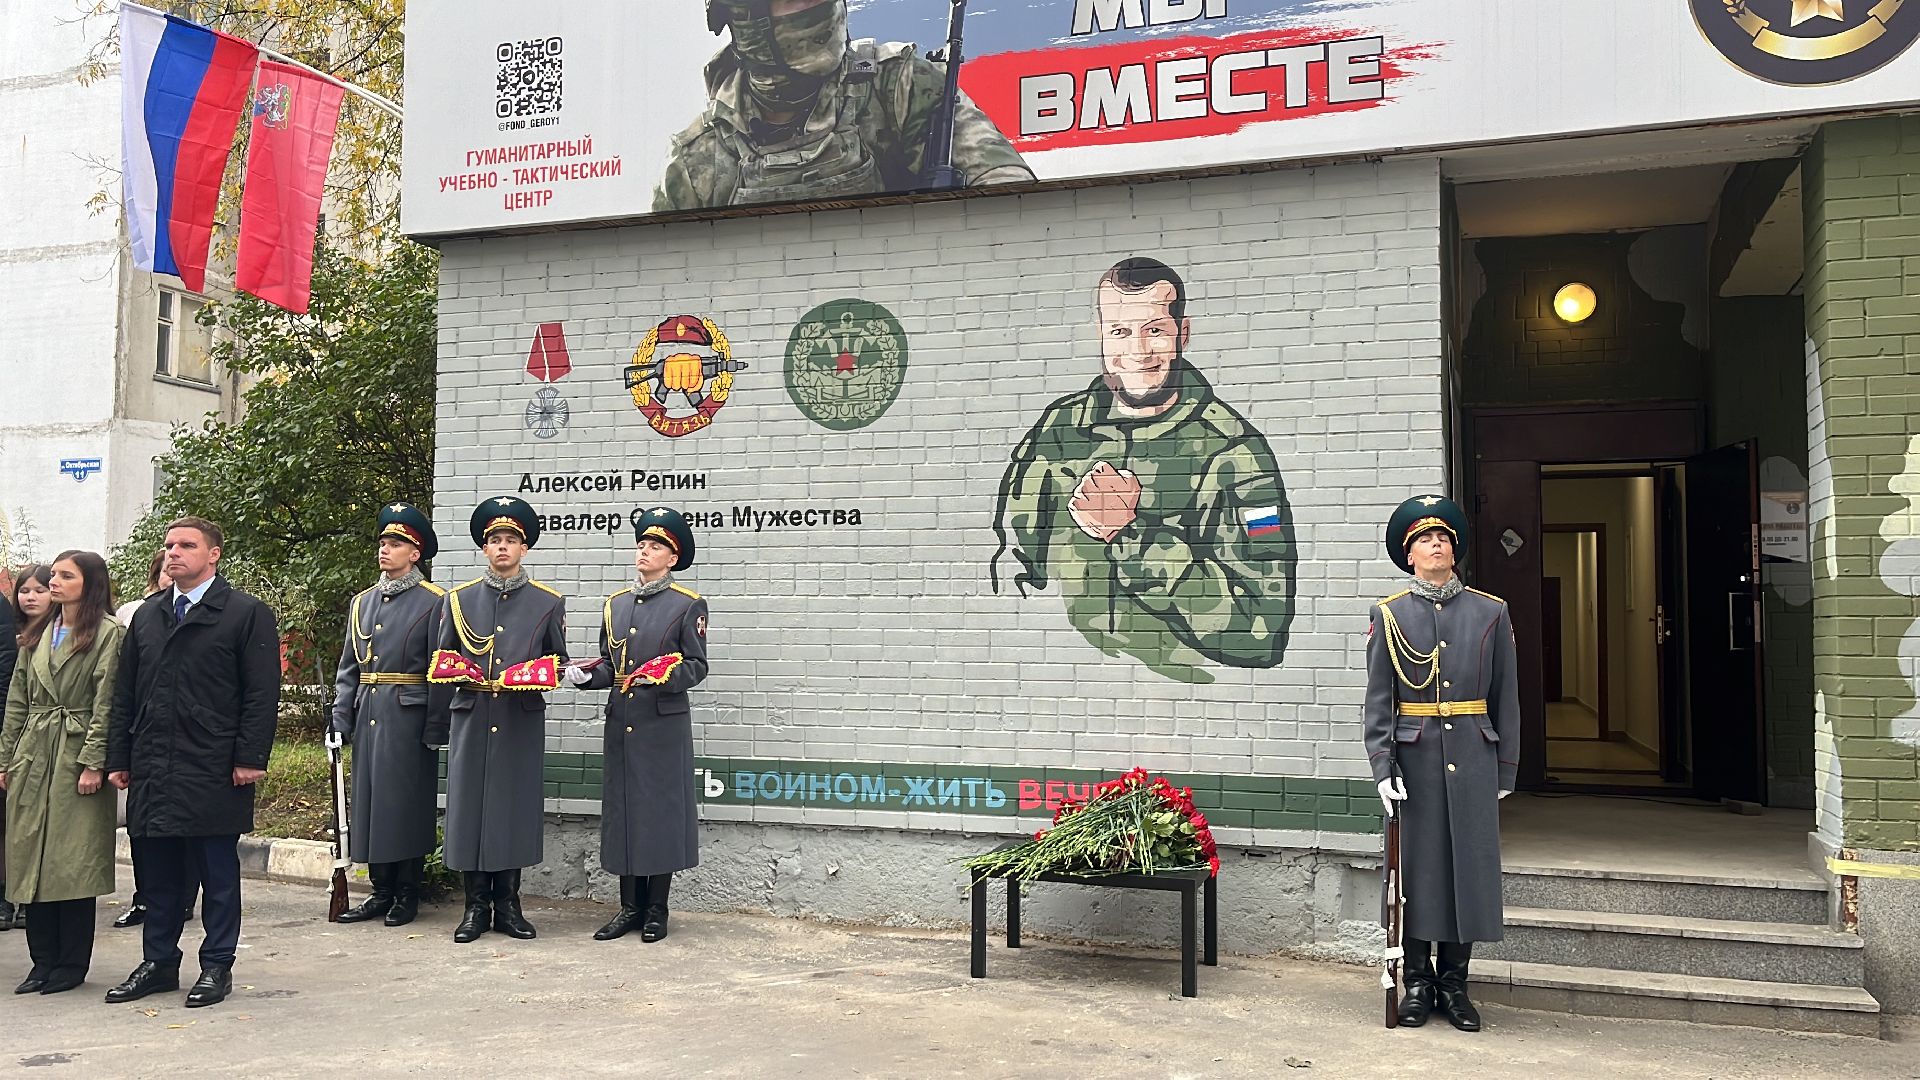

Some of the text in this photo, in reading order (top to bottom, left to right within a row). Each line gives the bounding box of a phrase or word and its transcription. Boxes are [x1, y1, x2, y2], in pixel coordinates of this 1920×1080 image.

[1020, 36, 1384, 136] ВМЕСТЕ
[498, 116, 560, 131] @FOND_GEROY1
[466, 134, 592, 167] ГУМАНИТАРНЫЙ
[439, 171, 498, 192] УЧЕБНО
[513, 155, 622, 185] ТАКТИЧЕСКИЙ
[504, 190, 553, 211] ЦЕНТР
[651, 414, 711, 434] ВИТЯЗЬ
[75, 470, 84, 478] 11
[518, 469, 706, 493] Алексей Репин
[539, 506, 862, 536] авалер Оена Мужества
[735, 770, 1007, 809] ВОИНОМ-ЖИТЬ
[1018, 778, 1100, 811] ВЕЧ
